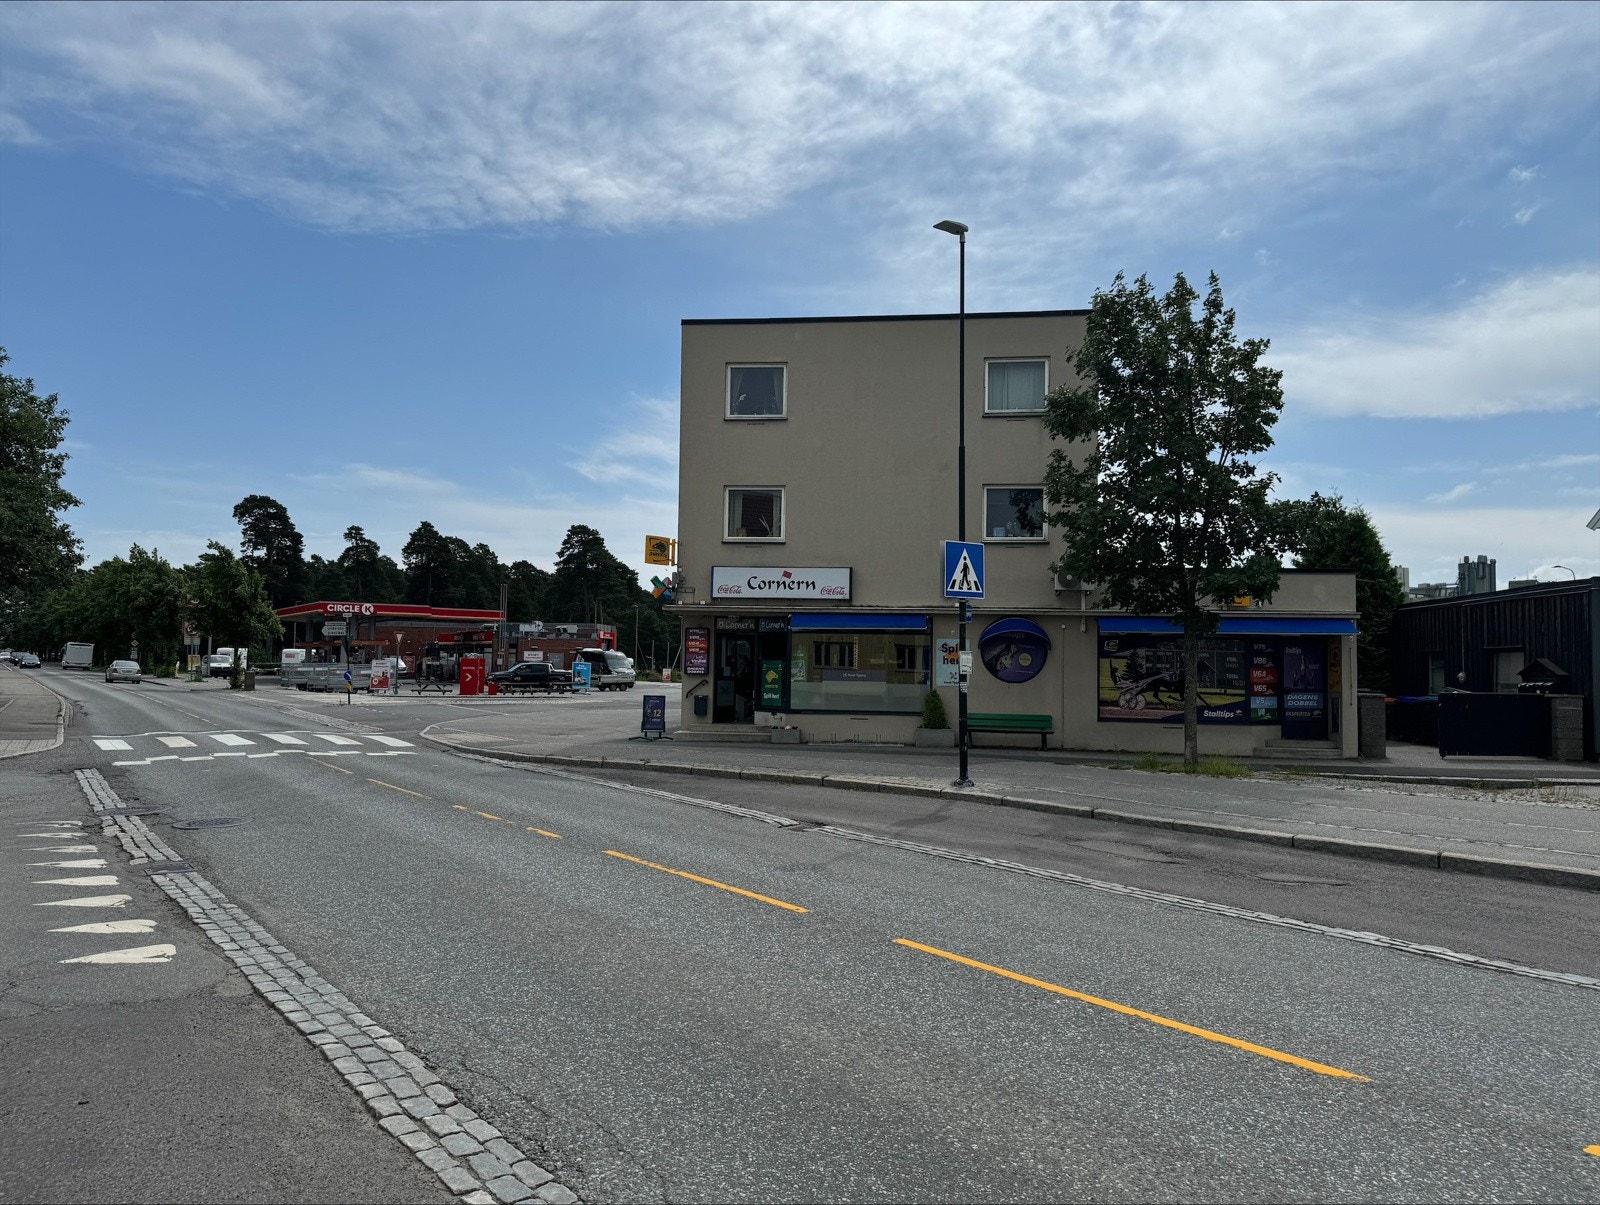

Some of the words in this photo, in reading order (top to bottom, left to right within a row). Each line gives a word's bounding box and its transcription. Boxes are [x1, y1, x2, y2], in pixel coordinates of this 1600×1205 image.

[747, 576, 816, 593] Cornern
[327, 604, 360, 613] CIRCLE
[364, 605, 373, 614] K
[1253, 657, 1267, 665] V86
[1252, 670, 1267, 678] V64
[1253, 685, 1267, 693] V65
[653, 709, 662, 717] 12
[1203, 710, 1235, 719] Stalltips
